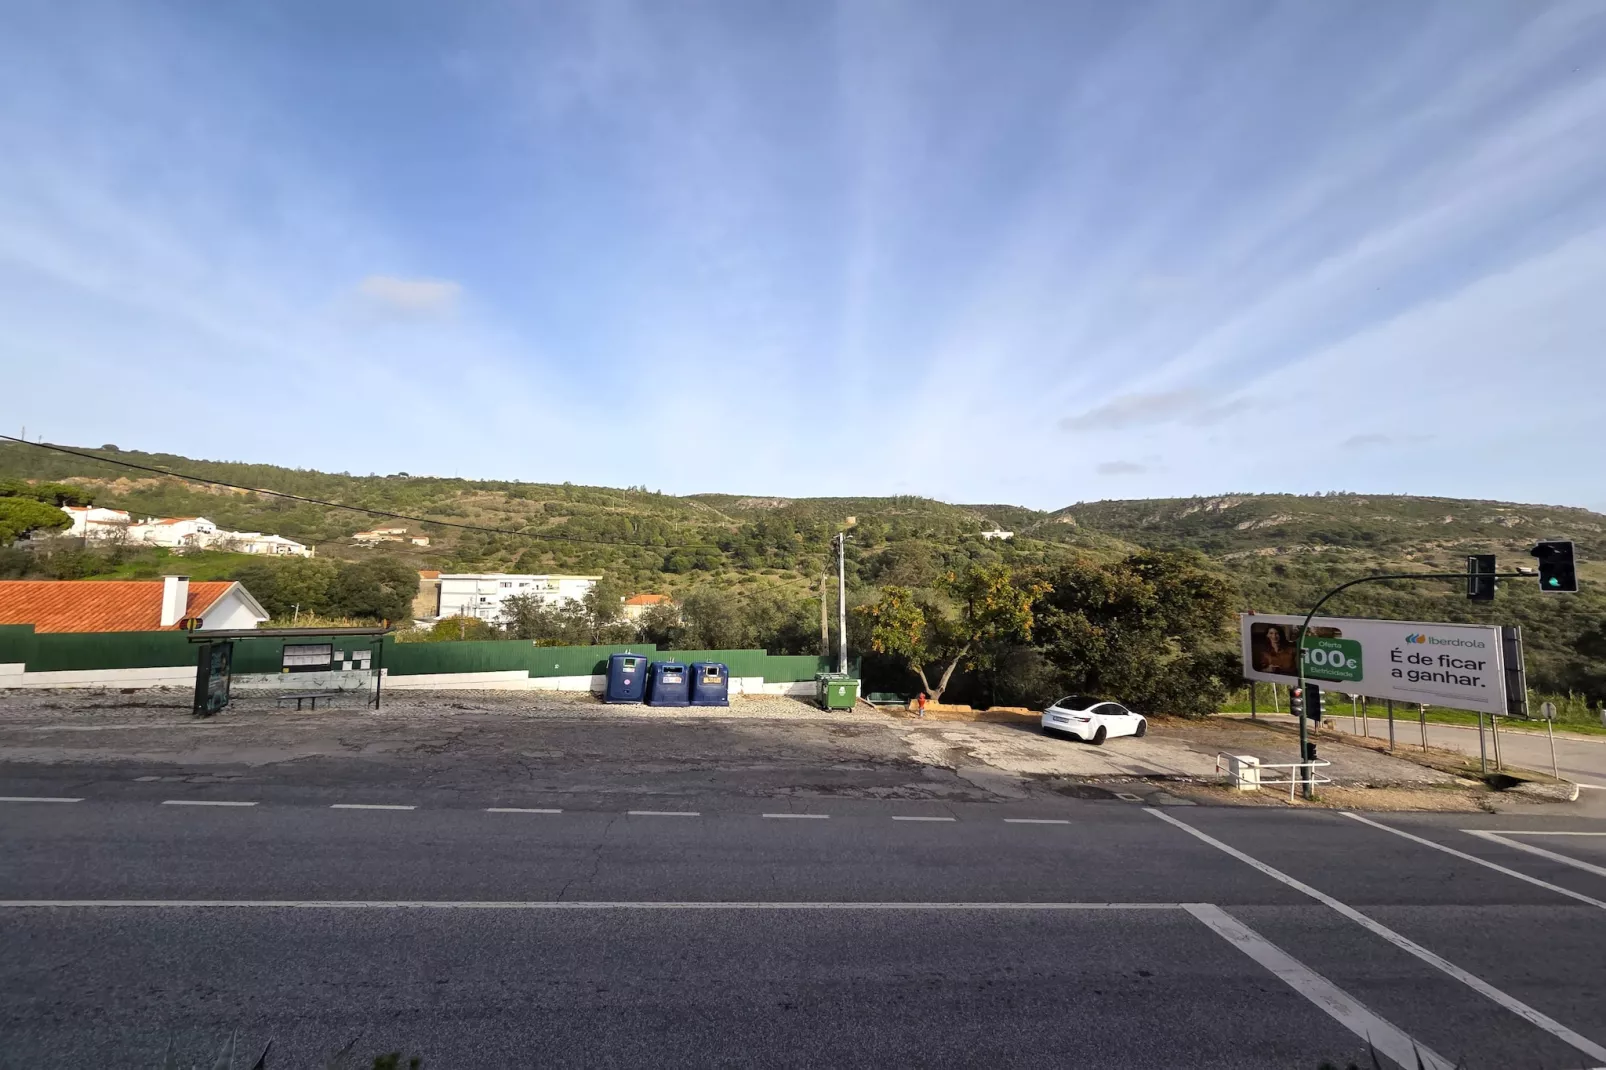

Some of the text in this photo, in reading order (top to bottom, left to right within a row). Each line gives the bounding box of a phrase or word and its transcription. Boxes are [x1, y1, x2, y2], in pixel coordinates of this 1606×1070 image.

[1318, 640, 1342, 649] Oferta
[1428, 636, 1485, 649] Iberdrola
[1390, 647, 1486, 671] É de ficar
[1310, 666, 1354, 678] Eletricidade
[1391, 667, 1486, 688] a ganhar.
